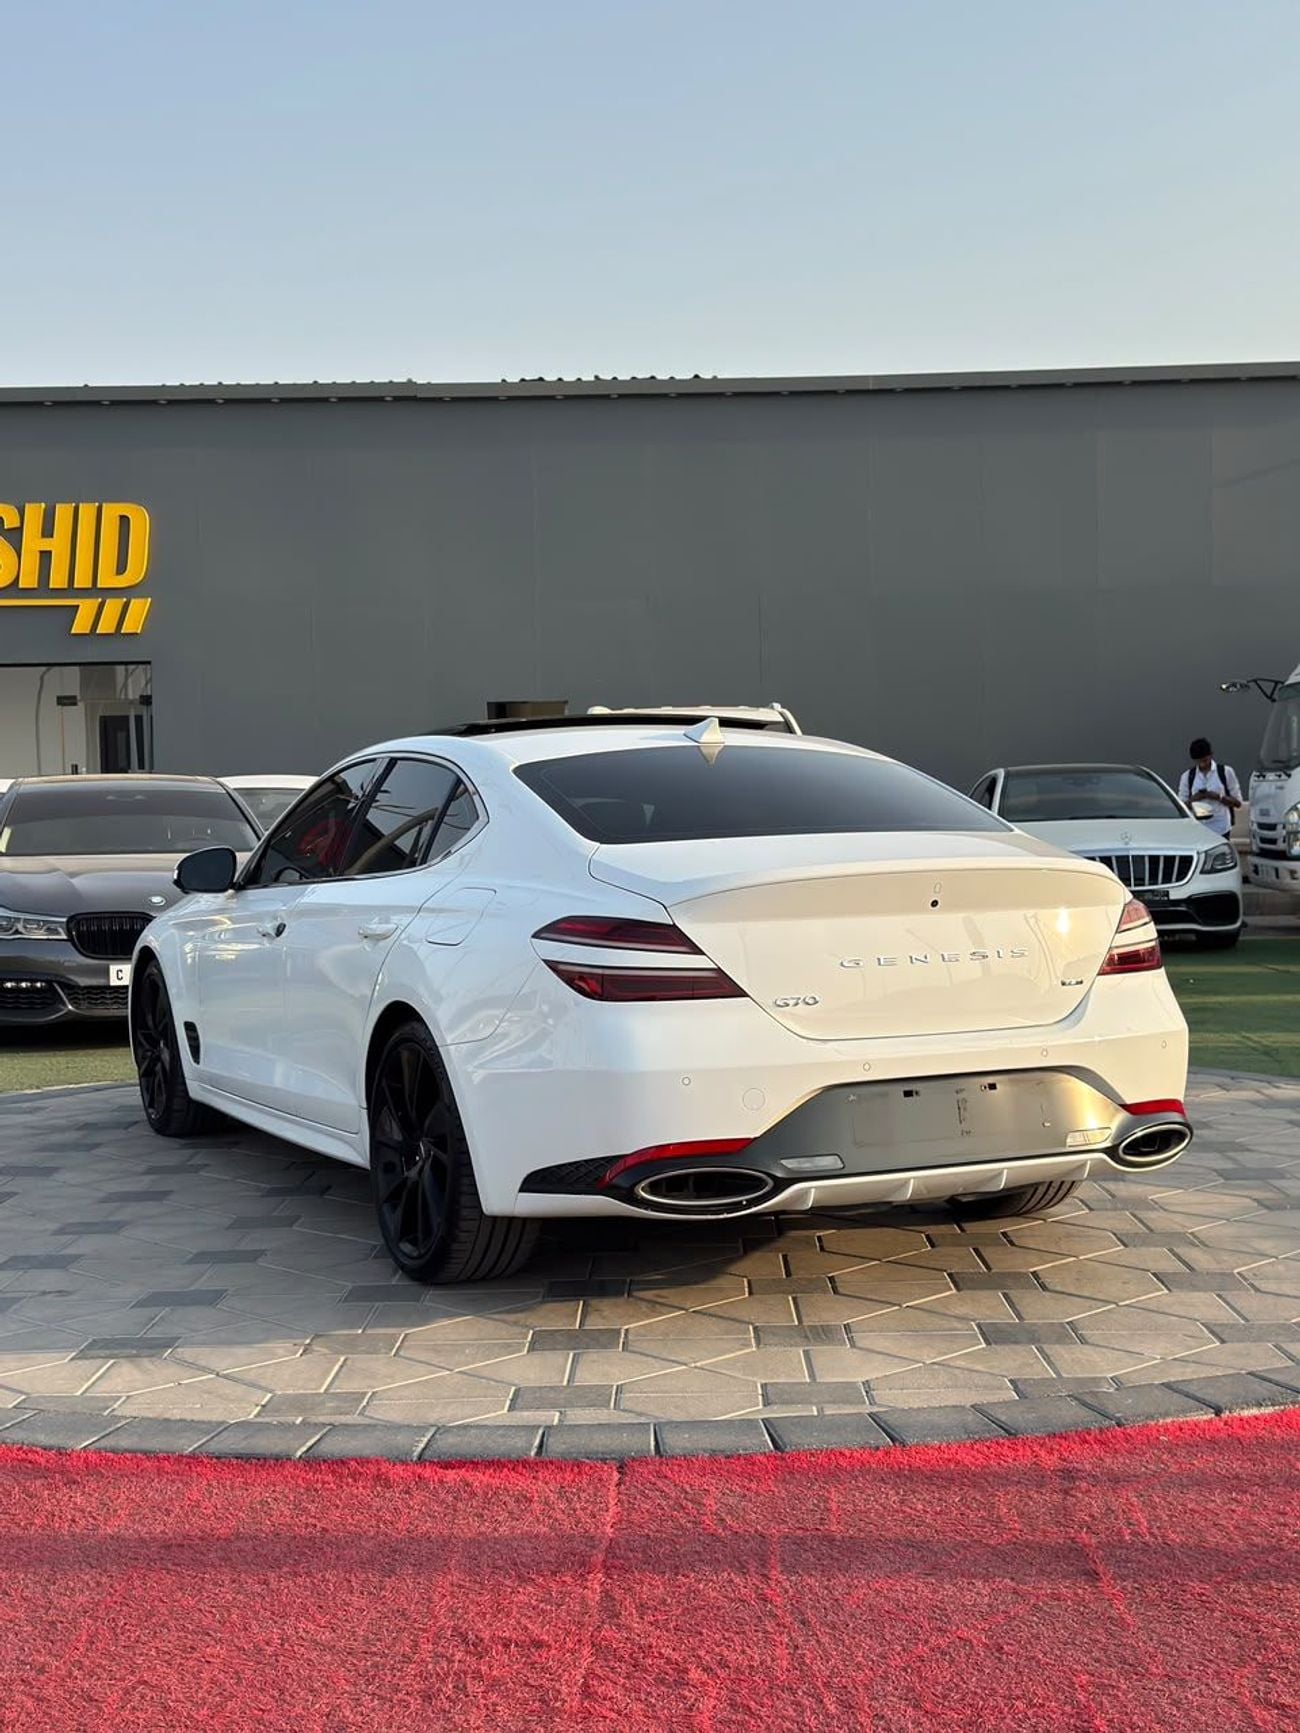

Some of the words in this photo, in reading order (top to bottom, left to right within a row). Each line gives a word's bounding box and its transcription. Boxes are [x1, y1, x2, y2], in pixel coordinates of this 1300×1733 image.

[839, 949, 1028, 968] GENESIS
[116, 969, 124, 981] C
[774, 996, 819, 1008] G70
